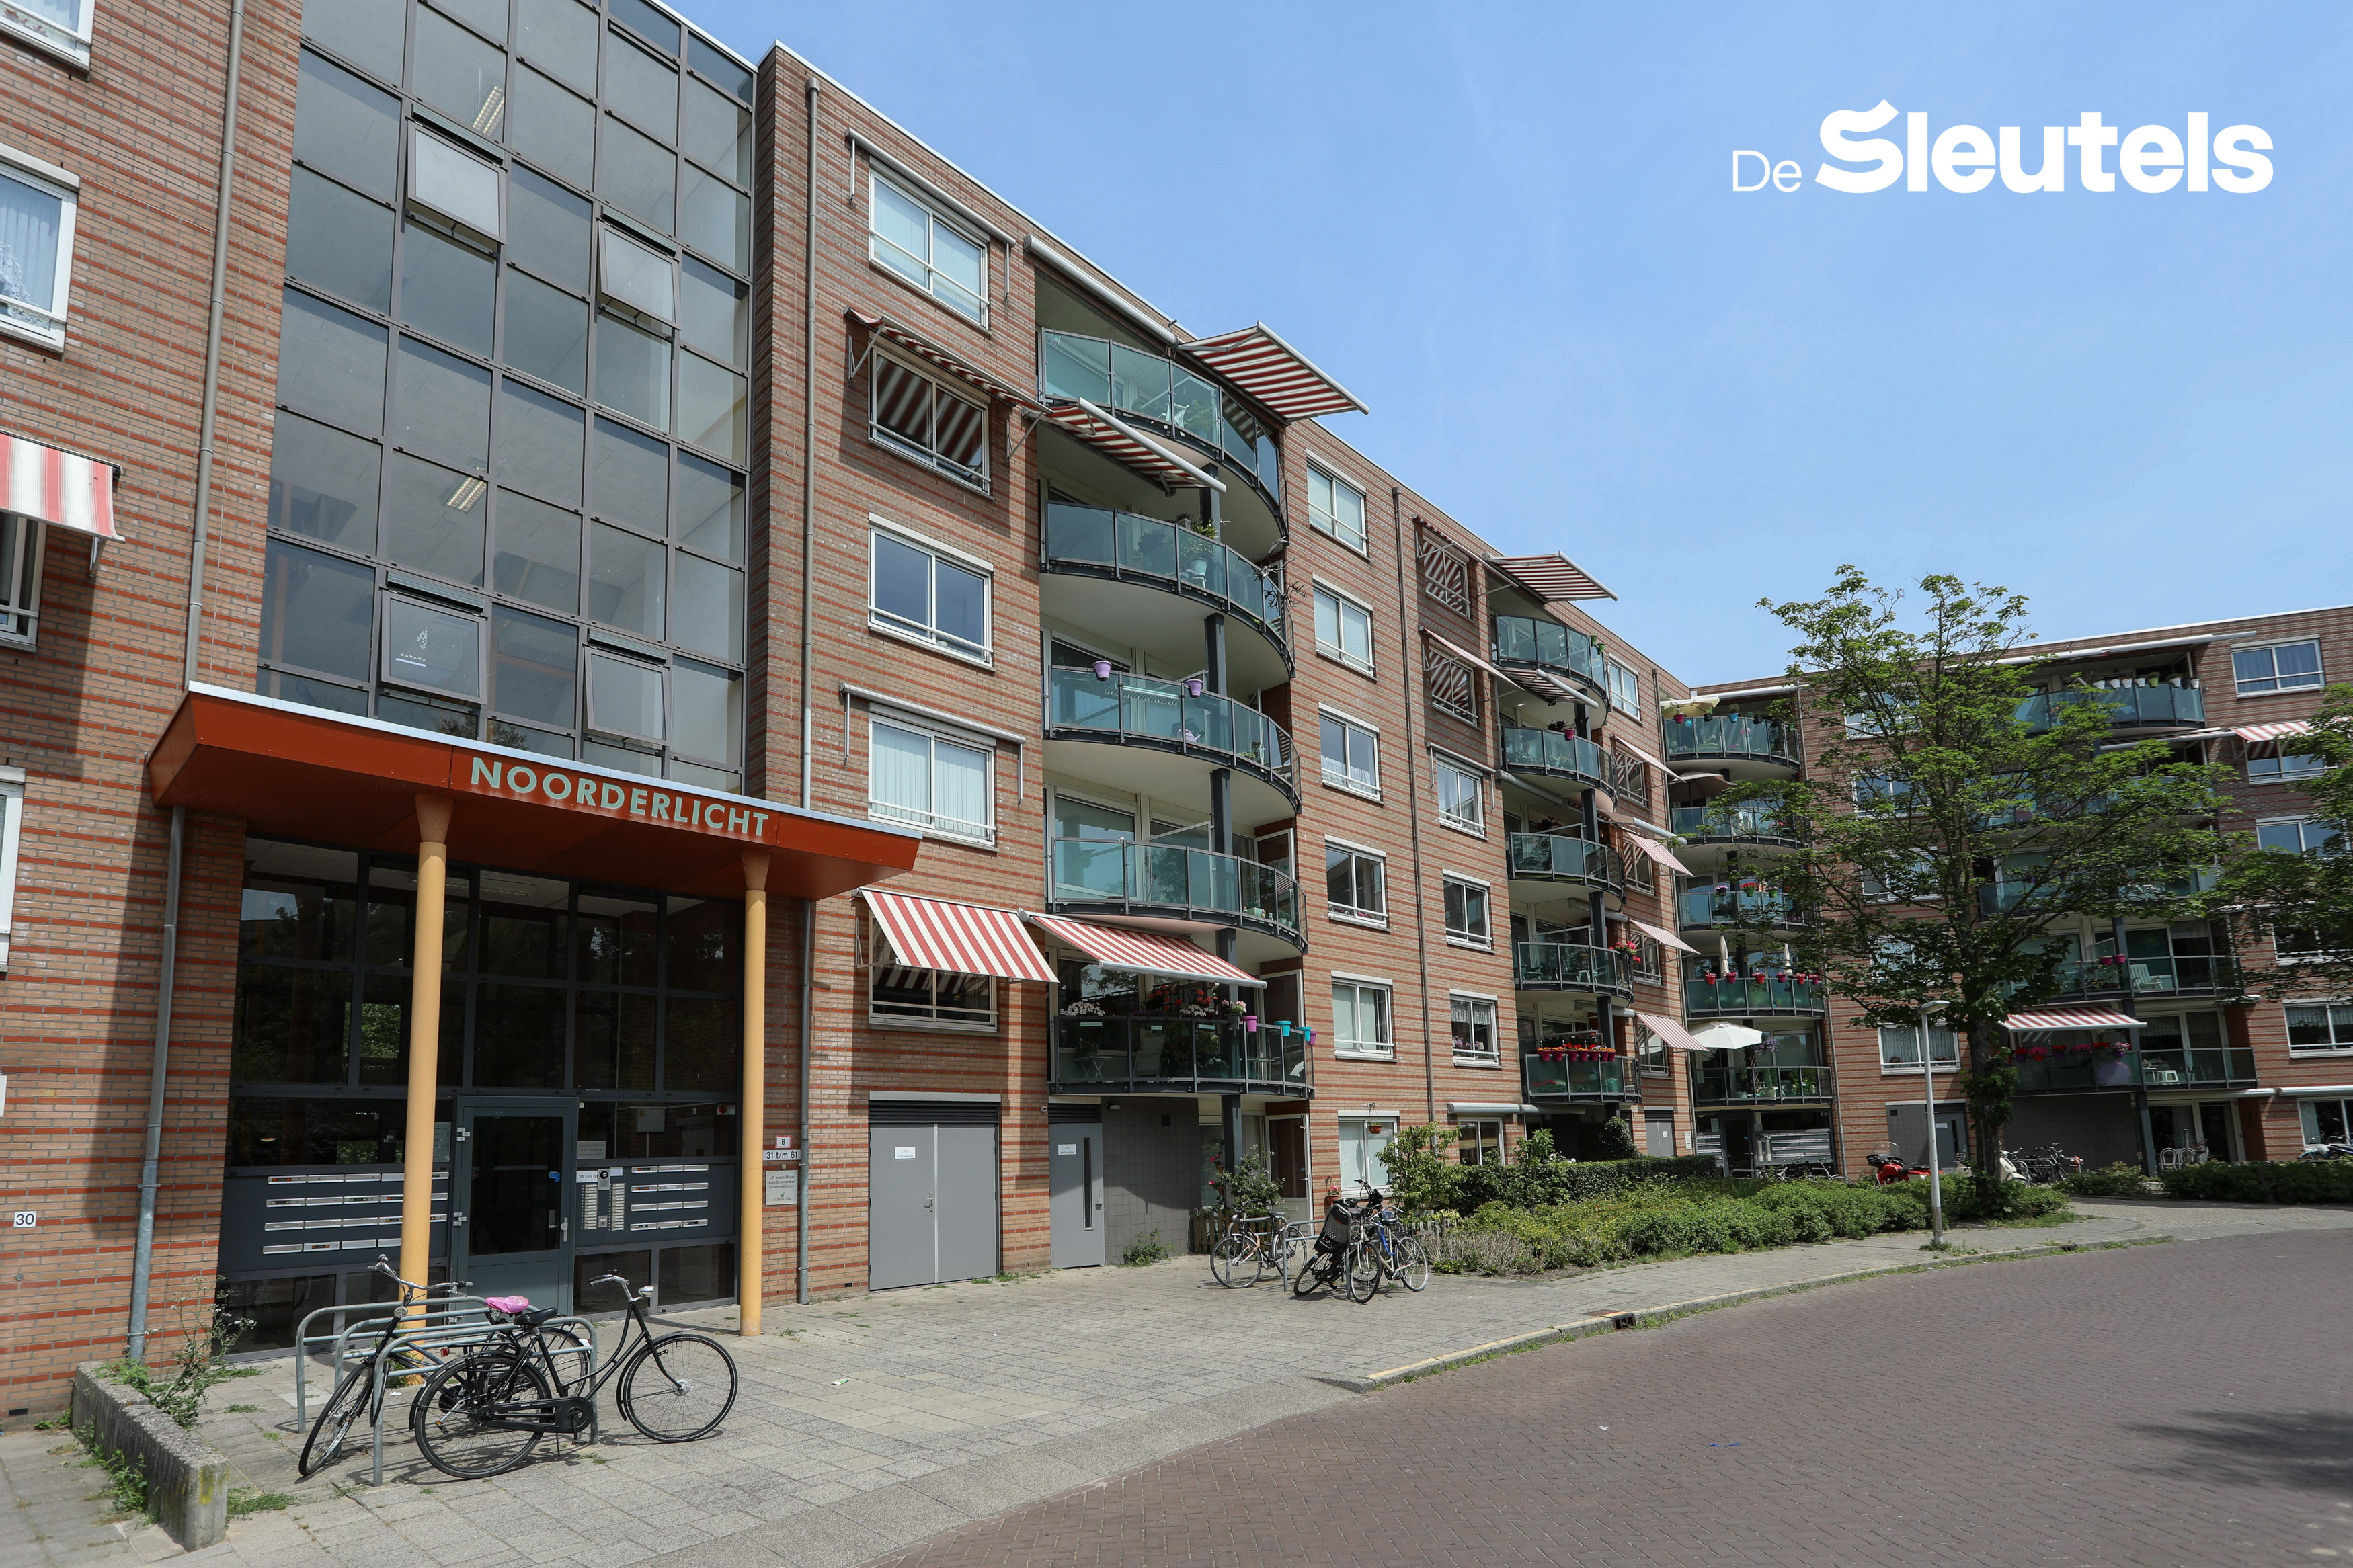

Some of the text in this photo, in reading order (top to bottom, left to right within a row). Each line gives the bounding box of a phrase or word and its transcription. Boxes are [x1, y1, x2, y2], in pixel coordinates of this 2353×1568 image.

[471, 757, 769, 837] NOORDERLICHT
[766, 1151, 774, 1159] 31
[790, 1151, 798, 1159] 61
[15, 1213, 34, 1225] 30
